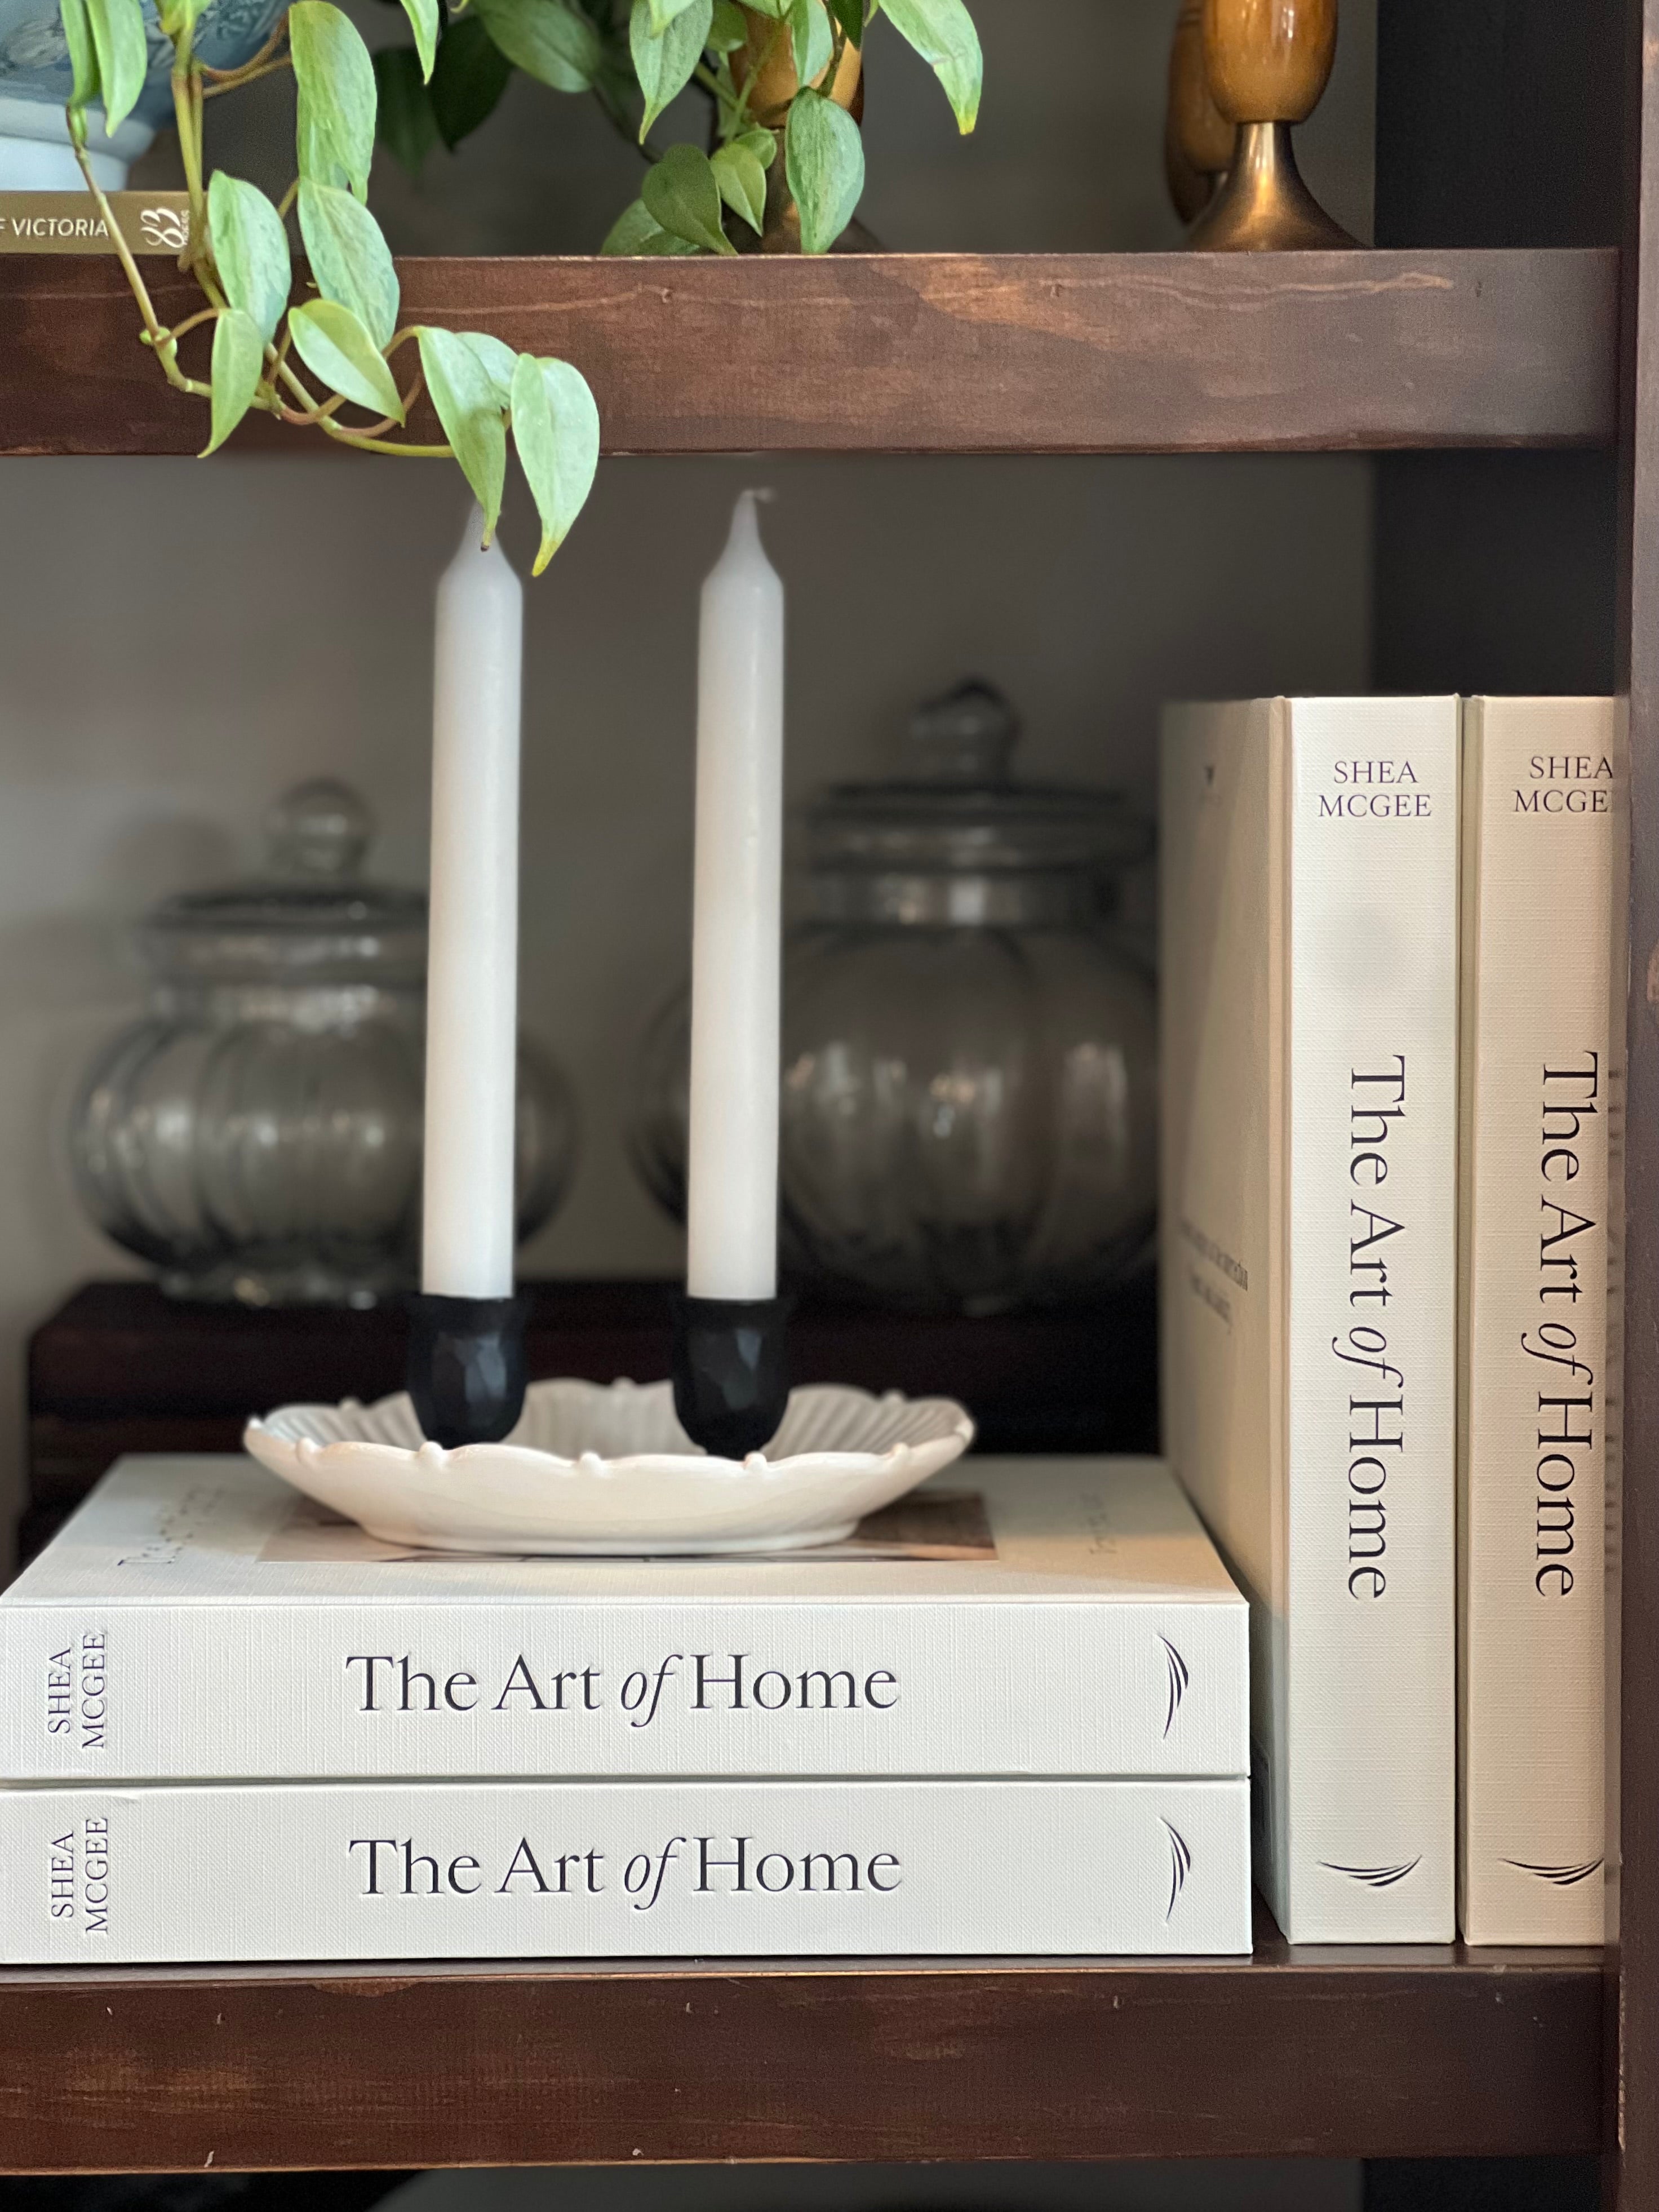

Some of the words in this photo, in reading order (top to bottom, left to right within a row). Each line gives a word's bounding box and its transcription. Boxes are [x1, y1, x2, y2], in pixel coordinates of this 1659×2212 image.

[11, 218, 109, 237] VICTORIA
[1318, 794, 1432, 818] MCGEE
[1334, 760, 1419, 784] SHEA
[1514, 789, 1609, 813] MCGE
[1529, 755, 1614, 779] SHEA
[1350, 1054, 1406, 1185] The
[1541, 1050, 1599, 1182] The
[1350, 1199, 1405, 1307] Art
[1539, 1194, 1596, 1304] Art
[1332, 1326, 1404, 1389] of
[1520, 1323, 1594, 1386] of
[1348, 1394, 1404, 1599] Home
[1535, 1391, 1594, 1597] Home
[47, 1647, 72, 1734] SHEA
[81, 1634, 105, 1749] MCGEE
[345, 1655, 478, 1711] The
[490, 1654, 601, 1710] Art
[620, 1654, 684, 1728] of
[690, 1654, 898, 1710] Home
[51, 1830, 74, 1918] SHEA
[85, 1817, 109, 1934] MCGEE
[349, 1837, 482, 1895] The
[494, 1836, 605, 1893] Art
[624, 1836, 687, 1910] of
[693, 1836, 902, 1892] Home
